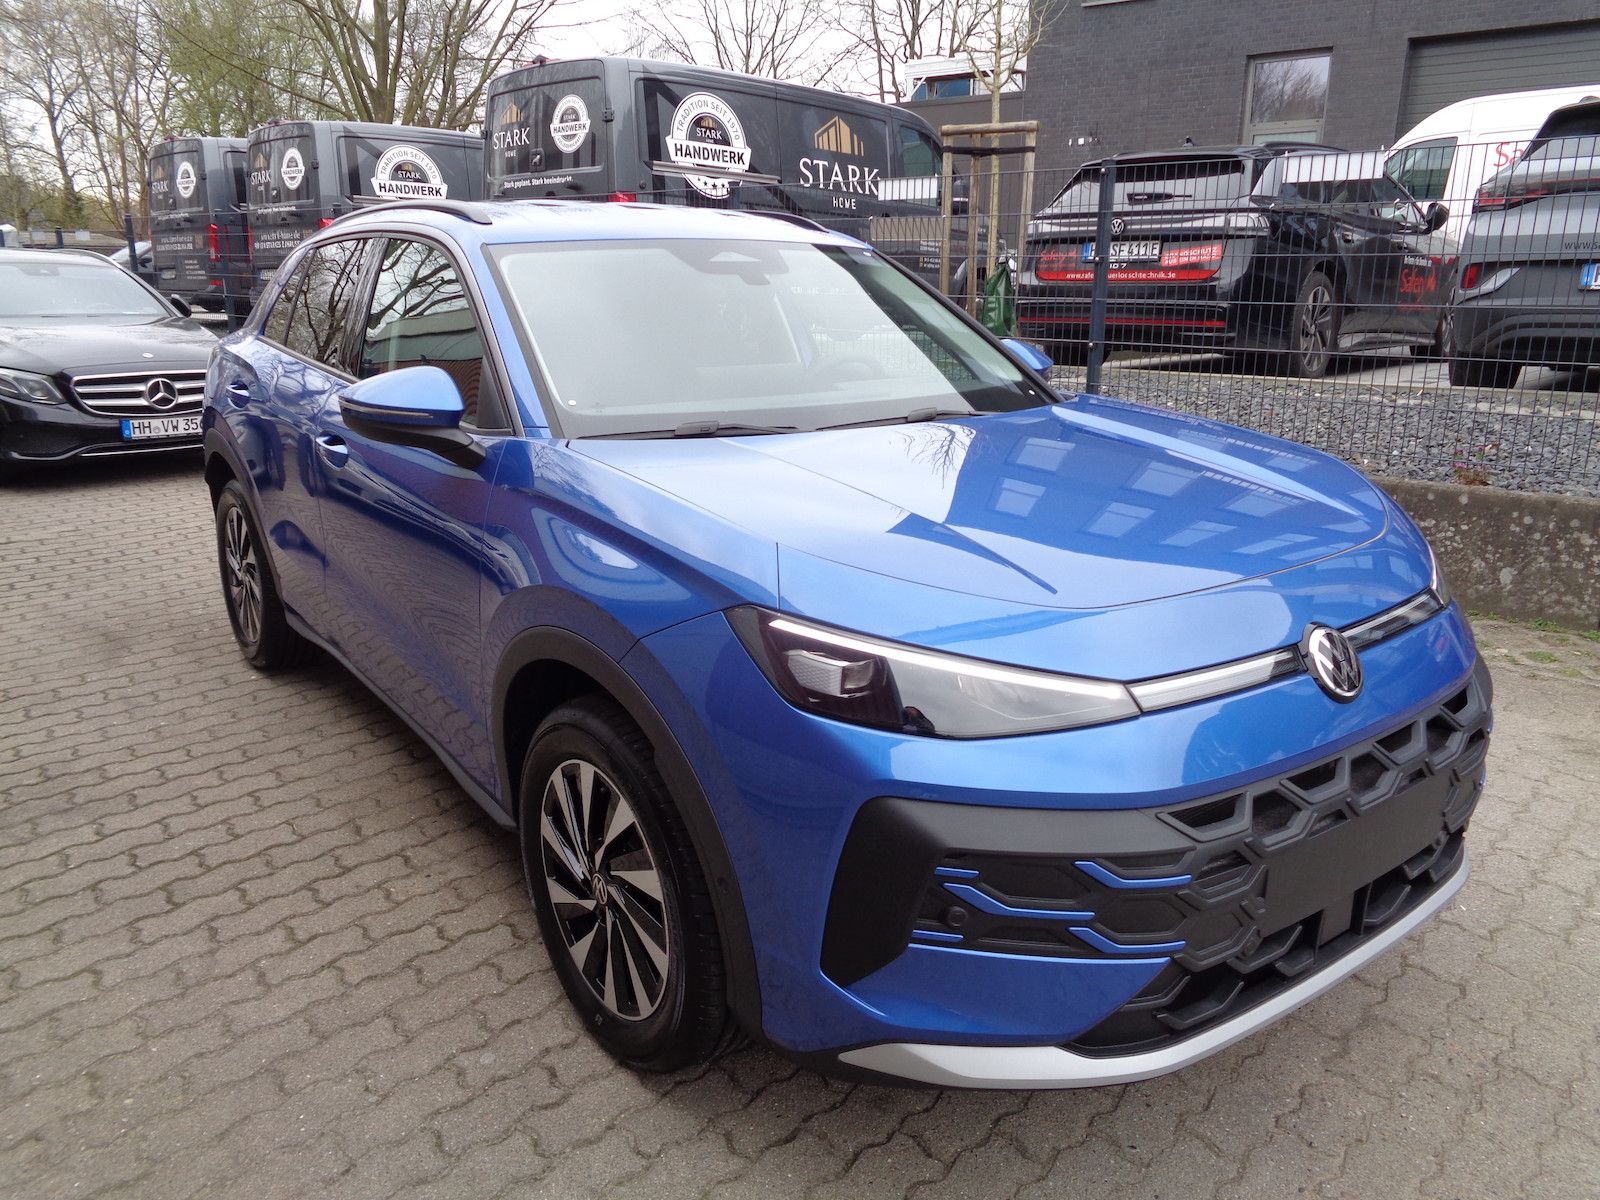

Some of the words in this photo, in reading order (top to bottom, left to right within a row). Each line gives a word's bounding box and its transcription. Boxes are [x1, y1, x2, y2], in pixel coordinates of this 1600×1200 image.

[553, 122, 588, 133] HANDWERK
[677, 99, 709, 132] TRADITION
[710, 101, 727, 118] SEIT
[727, 118, 740, 141] 1970
[493, 127, 530, 150] STARK
[696, 127, 722, 140] STARK
[674, 143, 746, 166] HANDWERK
[380, 150, 409, 175] TRADITION
[410, 152, 425, 163] SEIT
[251, 170, 271, 185] STARK
[397, 170, 421, 180] STARK
[532, 178, 543, 186] Stark
[799, 157, 881, 196] STARK
[152, 180, 169, 194] STARK
[378, 182, 443, 197] HANDWERK
[832, 196, 857, 210] HOME
[131, 421, 152, 435] HH
[161, 419, 179, 433] VW
[183, 418, 204, 431] 35
